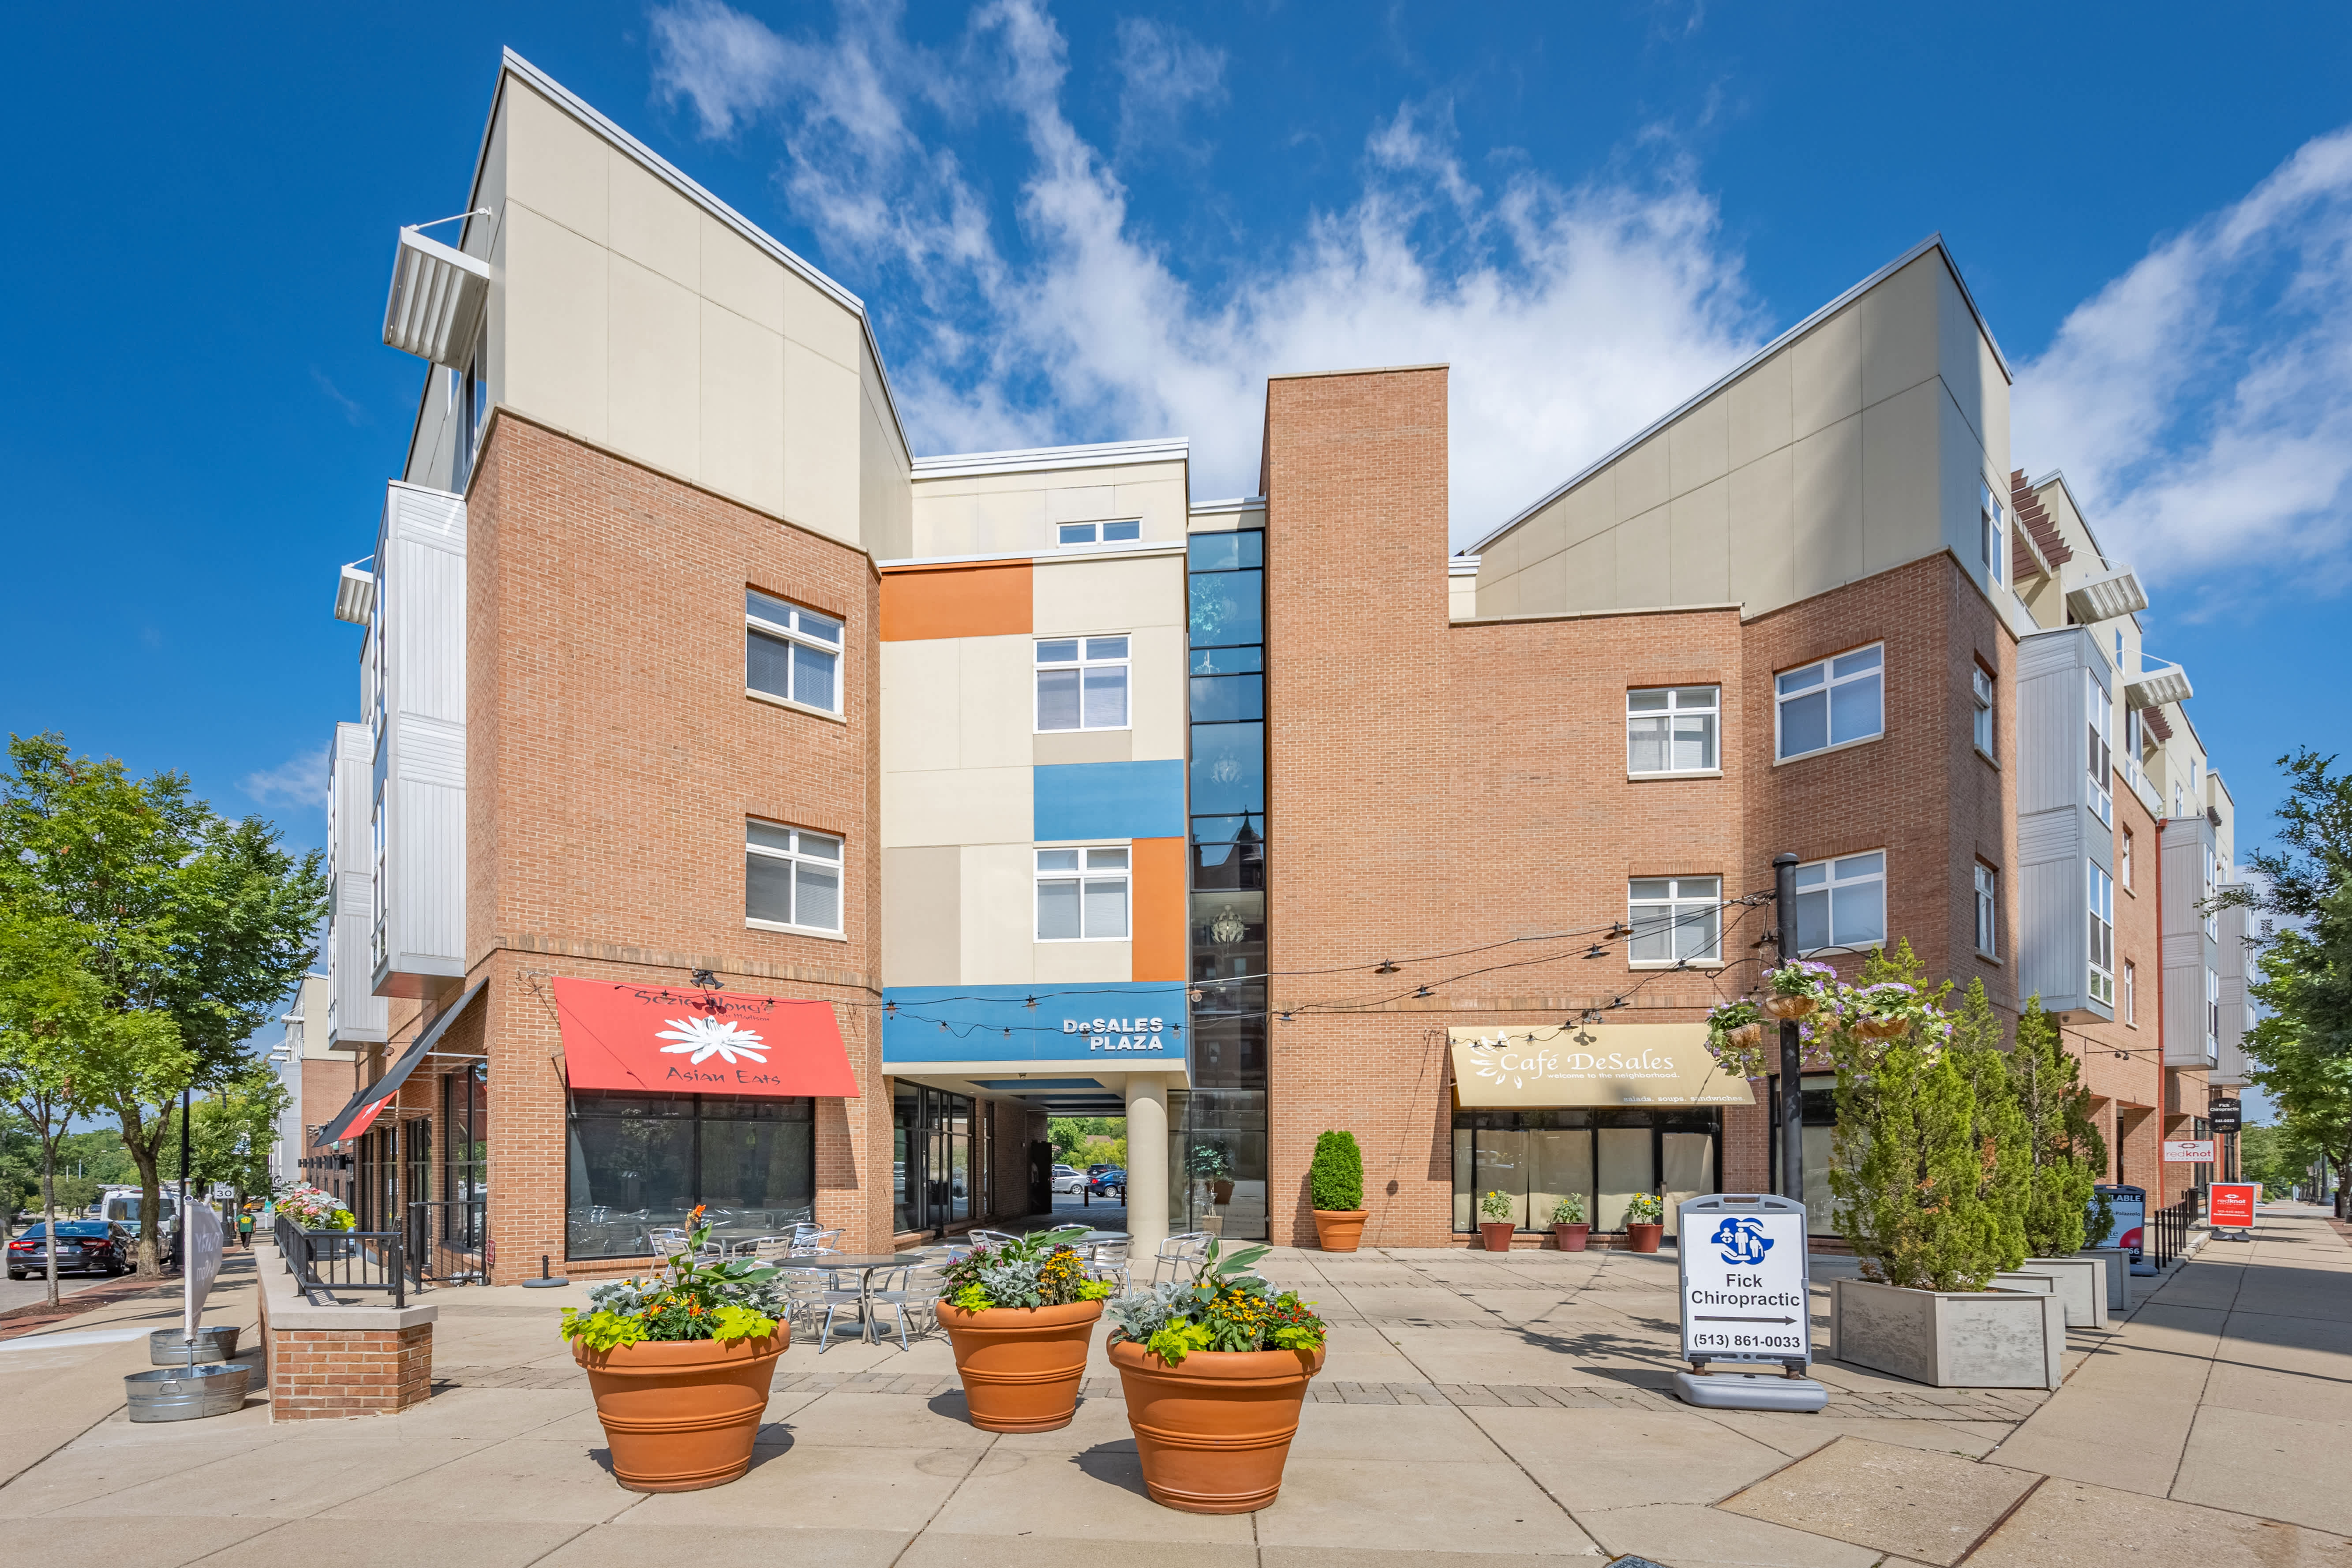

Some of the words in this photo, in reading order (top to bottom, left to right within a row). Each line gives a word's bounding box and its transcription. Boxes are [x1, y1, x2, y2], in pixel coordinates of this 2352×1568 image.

[1063, 1018, 1164, 1034] DeSALES
[1090, 1035, 1164, 1051] PLAZA
[1500, 1049, 1559, 1079] Café
[1567, 1048, 1674, 1070] DeSales
[666, 1067, 725, 1083] Asian
[736, 1070, 780, 1086] Eats
[1727, 1273, 1763, 1287] Fick
[1691, 1291, 1800, 1308] Chiropractic
[1694, 1334, 1729, 1348] (513)
[1734, 1335, 1800, 1347] 861-0033
